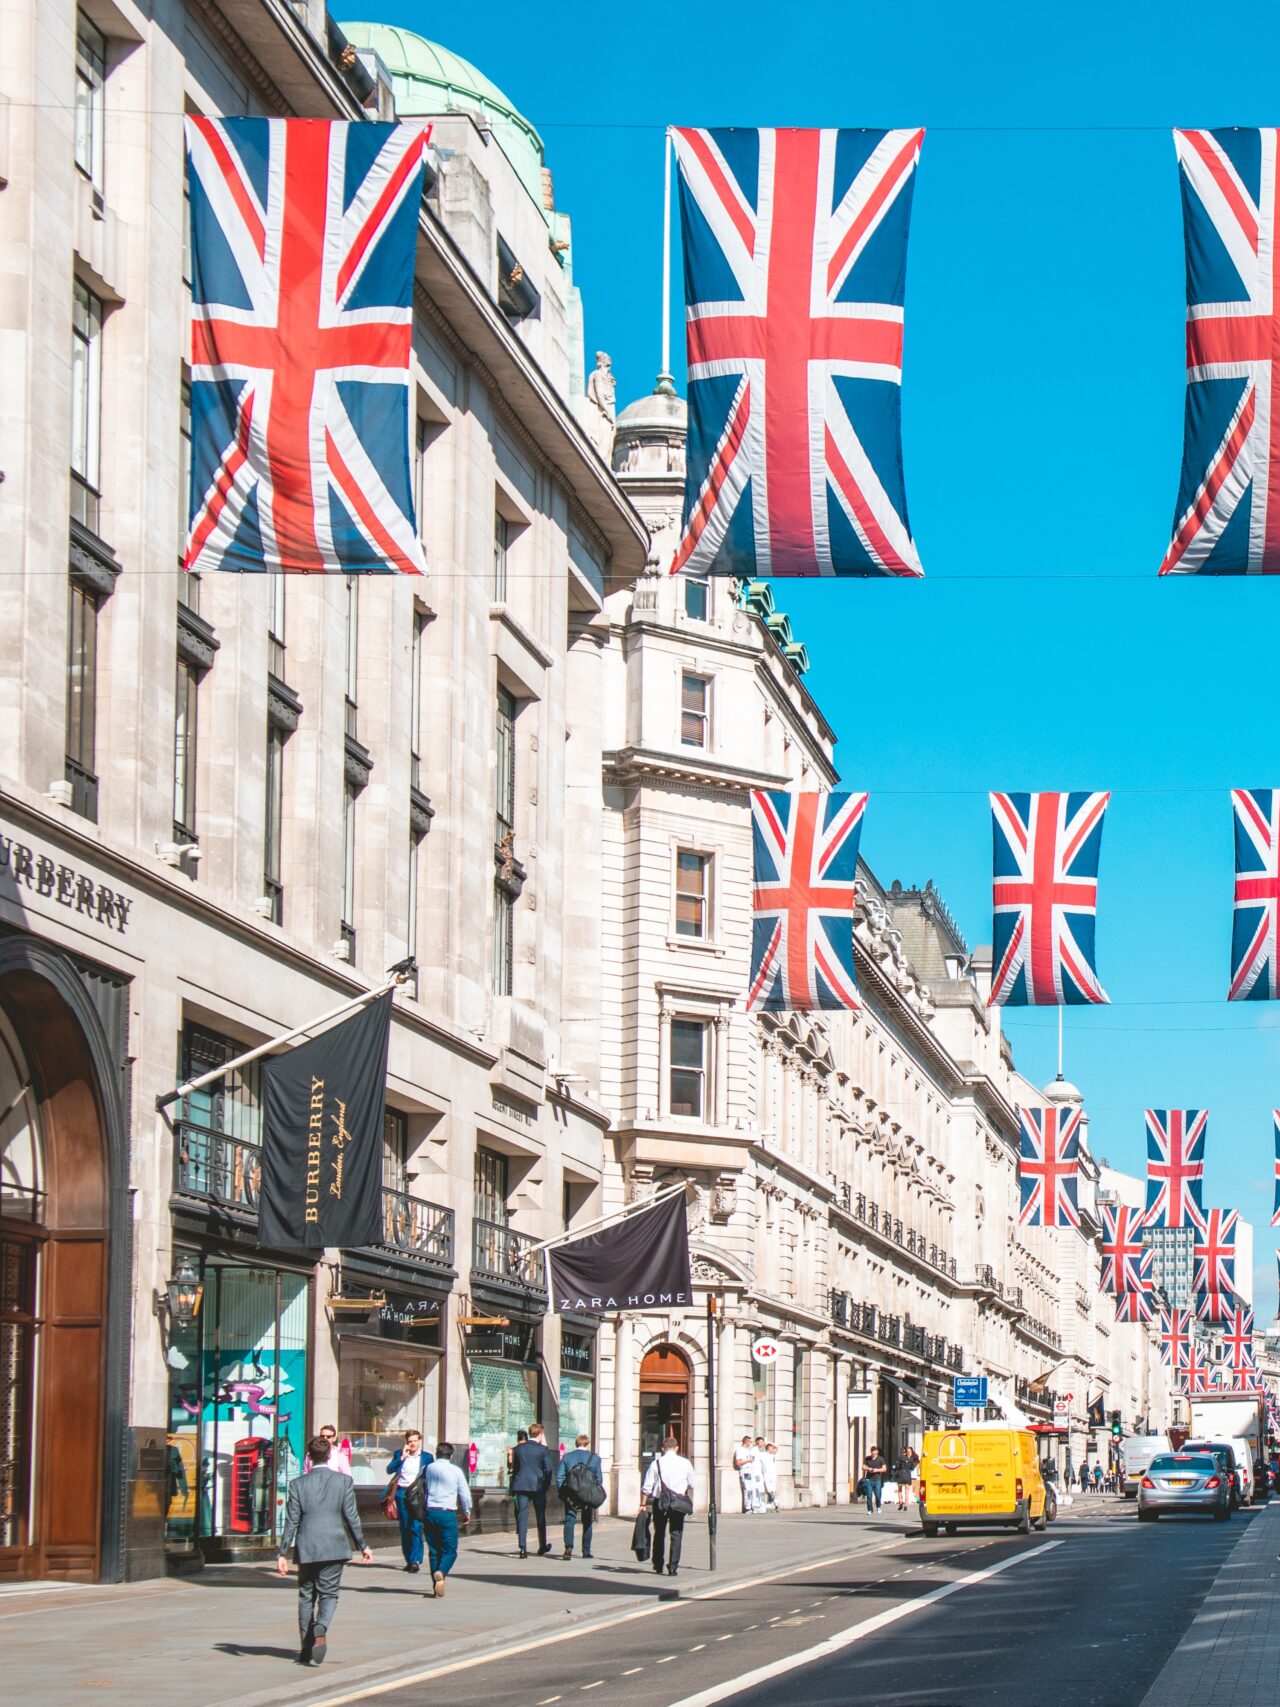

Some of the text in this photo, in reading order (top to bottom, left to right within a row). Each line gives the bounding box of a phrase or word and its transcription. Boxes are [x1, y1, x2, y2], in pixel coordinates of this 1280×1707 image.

[331, 1098, 352, 1149] England
[306, 1074, 325, 1224] BURBERRY
[560, 1293, 686, 1310] ZARA HOME
[394, 1311, 414, 1325] HOME
[504, 1334, 520, 1346] HOME
[561, 1346, 589, 1360] ZARA HOME
